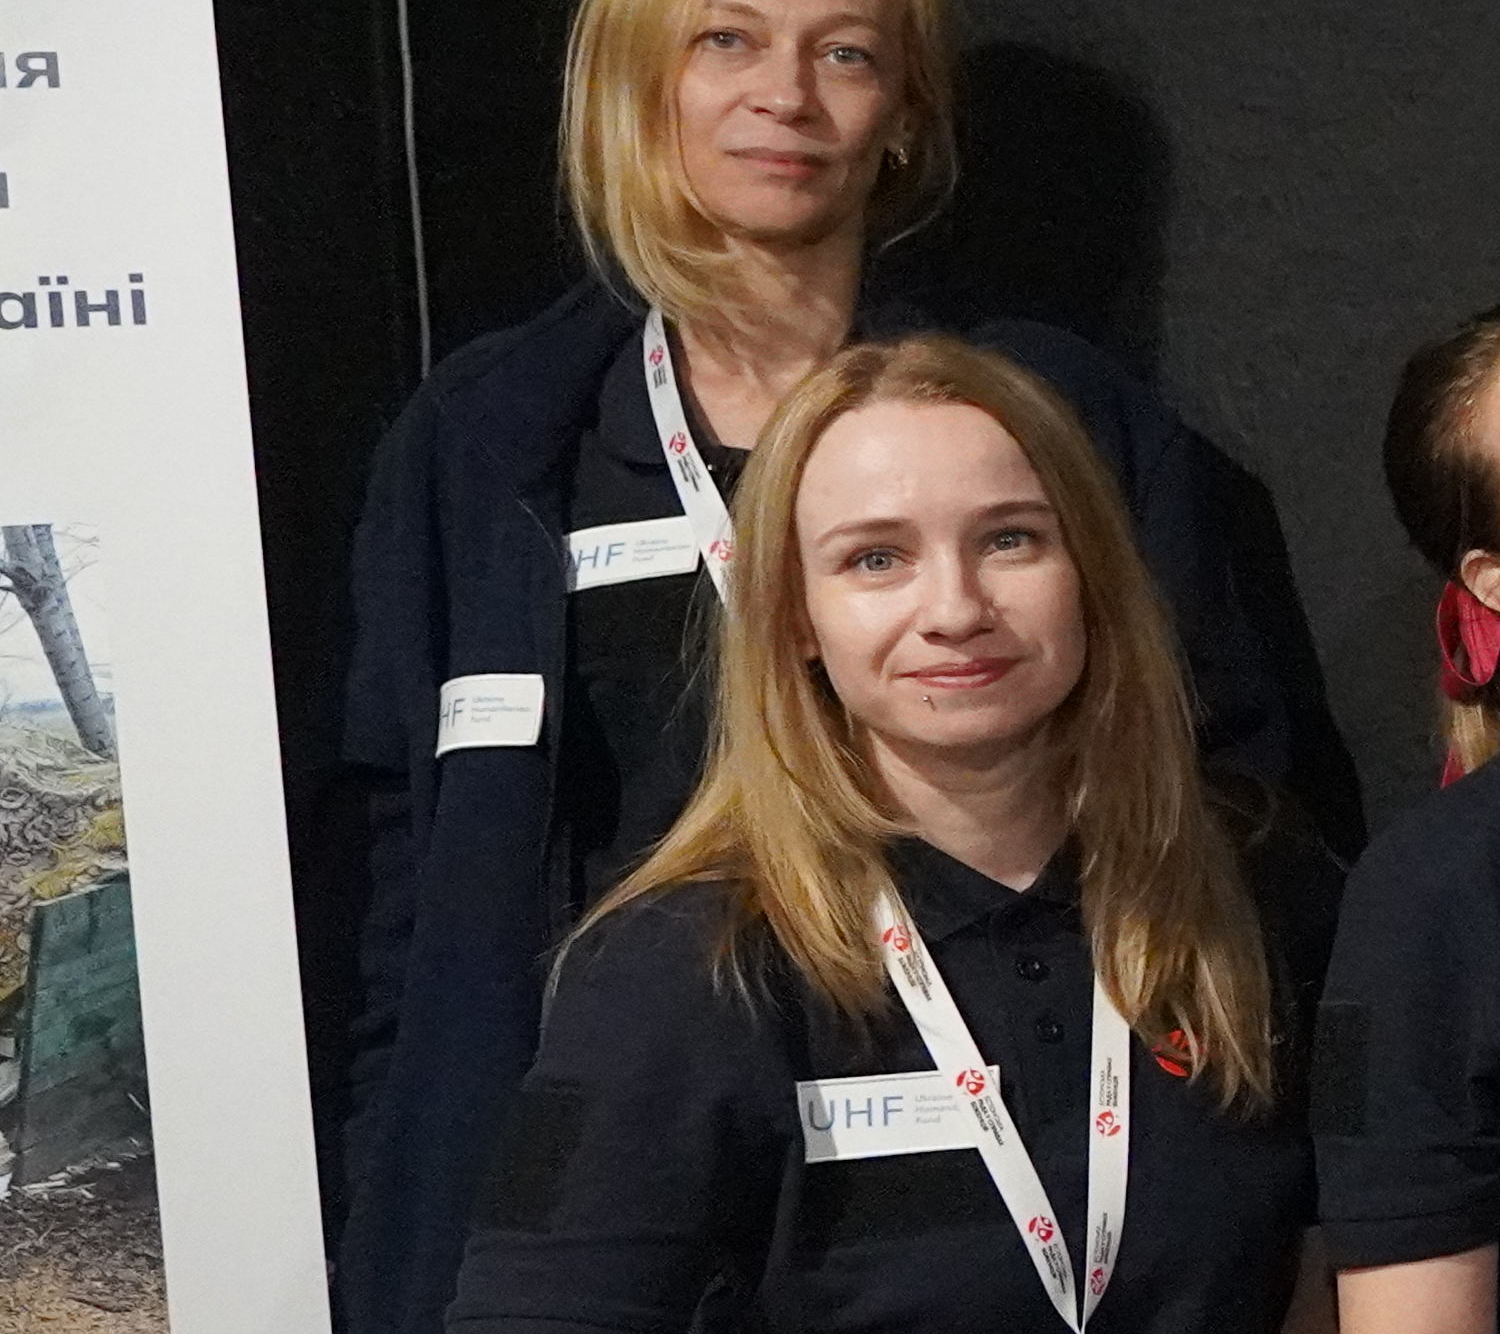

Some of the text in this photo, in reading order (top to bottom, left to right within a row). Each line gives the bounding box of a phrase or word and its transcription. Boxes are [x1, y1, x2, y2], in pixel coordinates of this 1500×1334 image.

[576, 542, 626, 569] HF
[441, 697, 466, 729] HF
[808, 1096, 904, 1131] UHF
